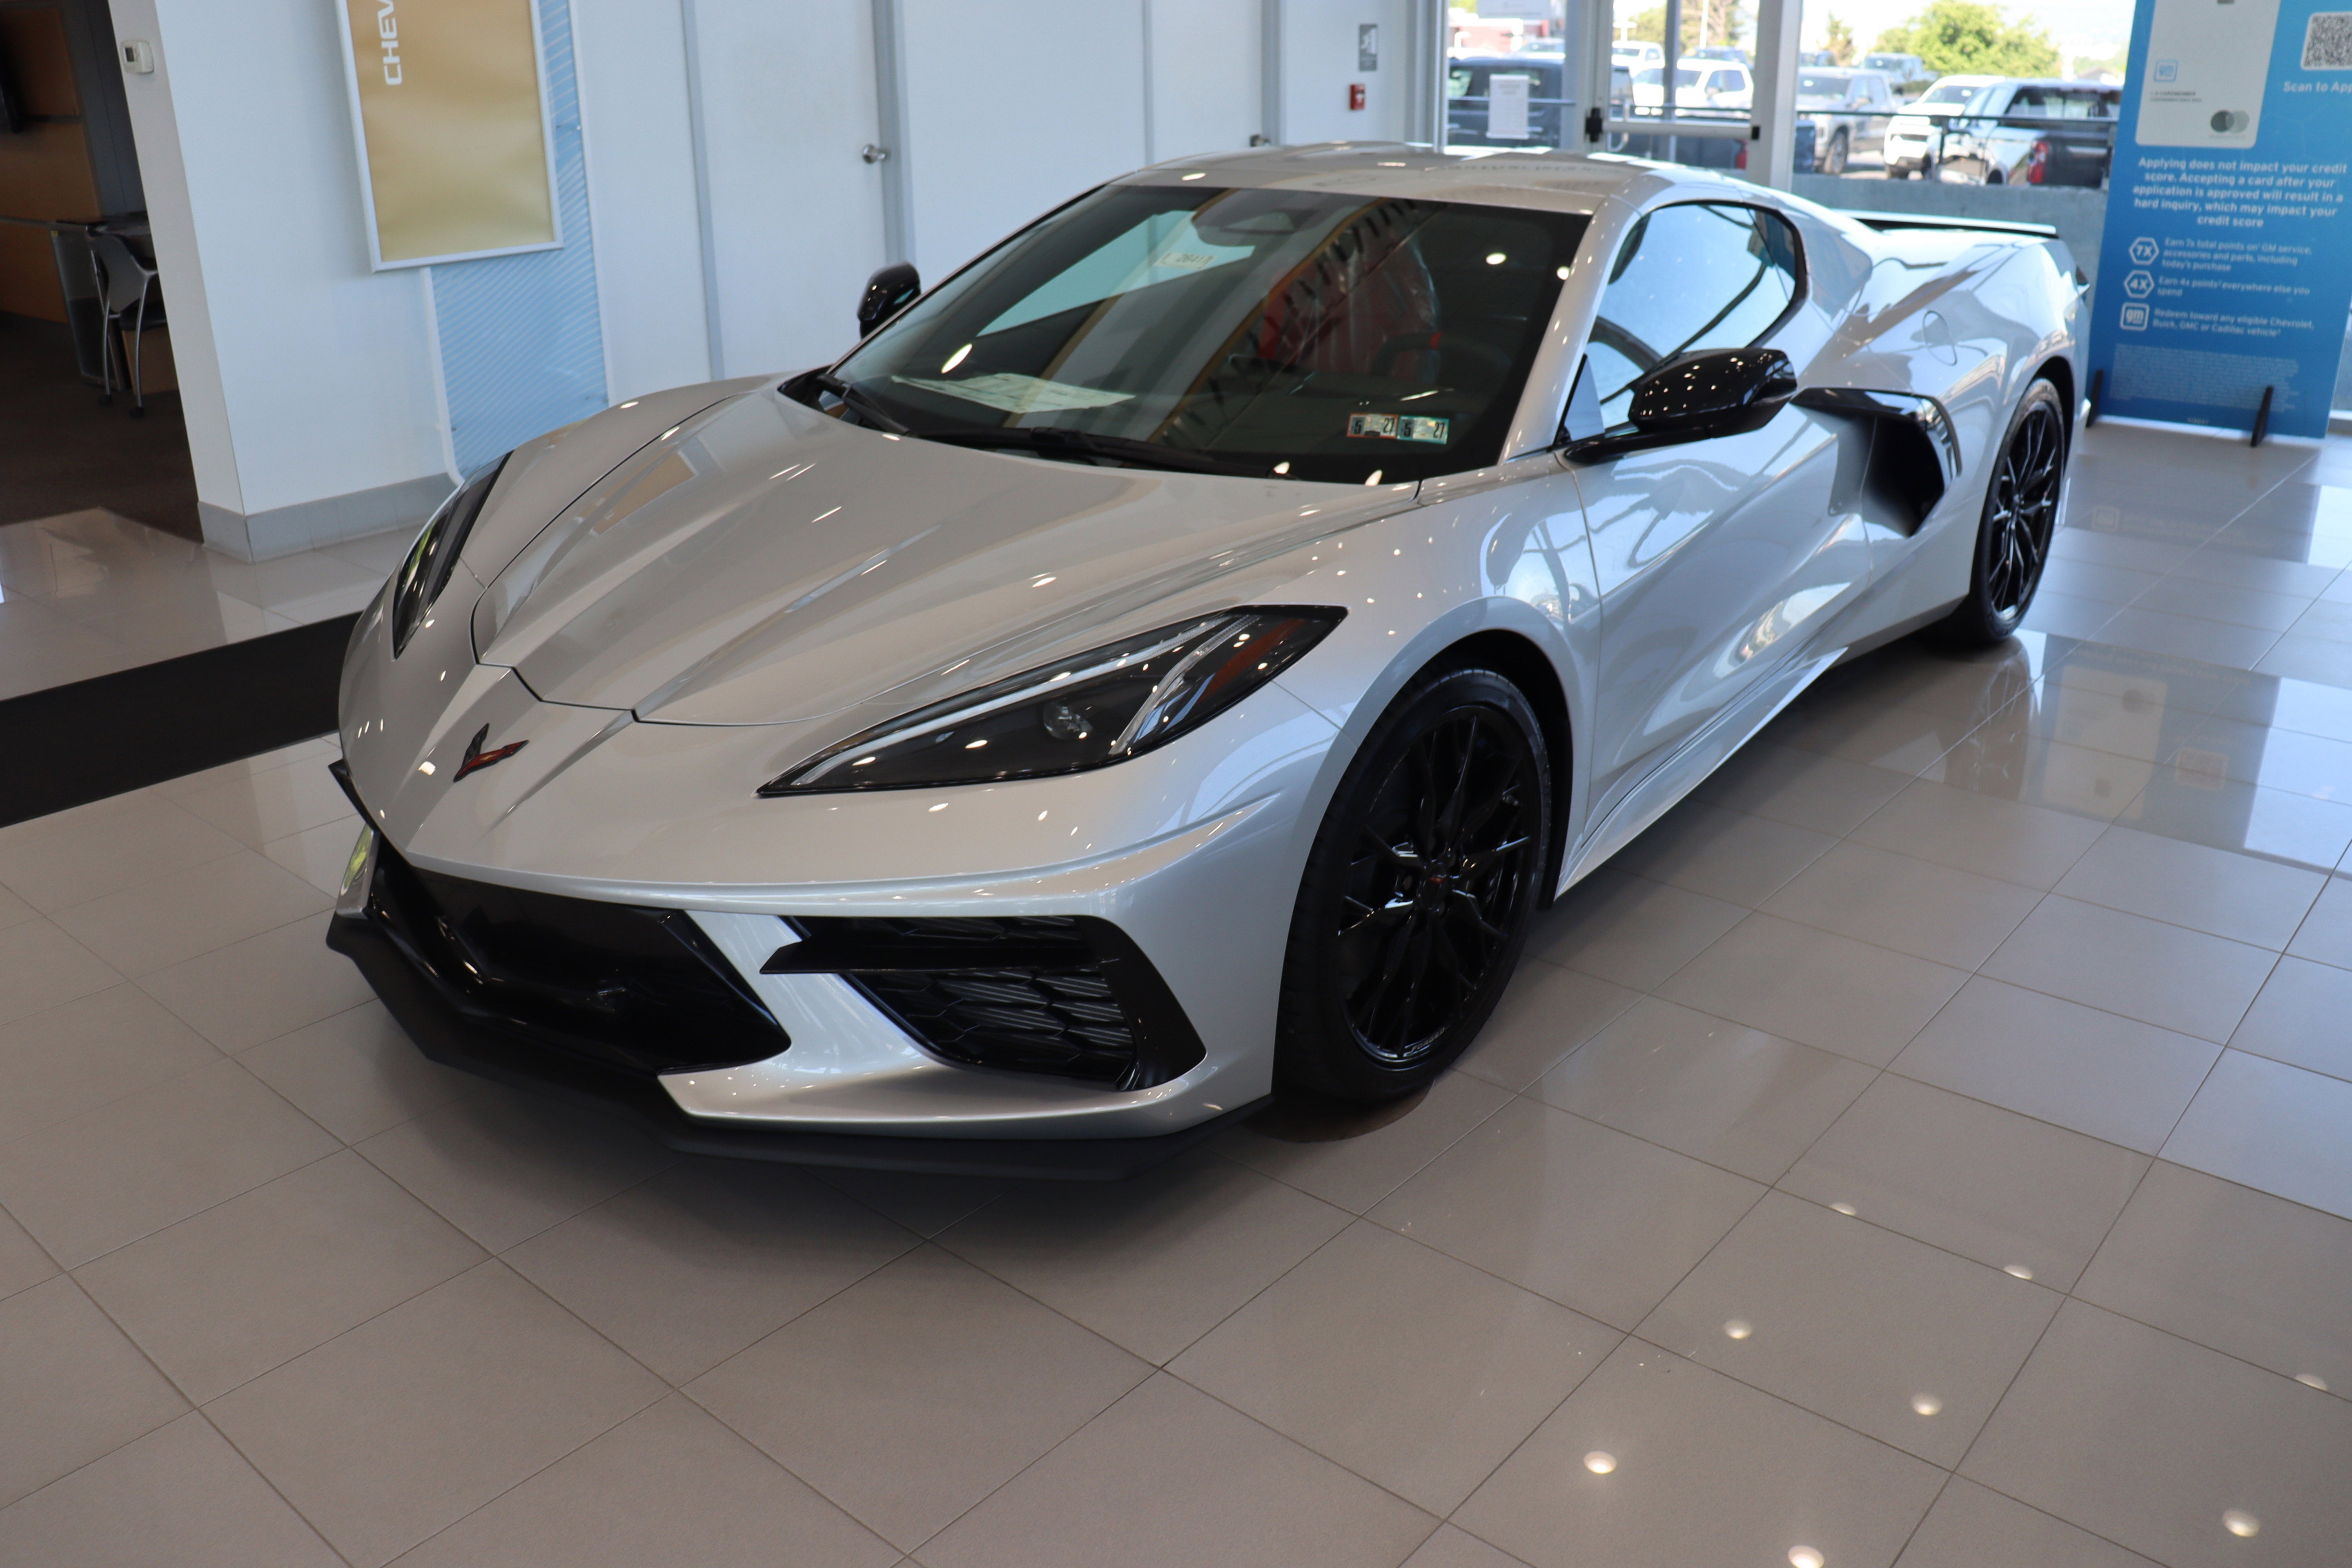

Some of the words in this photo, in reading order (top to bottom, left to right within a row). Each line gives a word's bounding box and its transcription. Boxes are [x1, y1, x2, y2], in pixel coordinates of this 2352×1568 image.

[377, 0, 402, 85] CHEV
[2283, 82, 2312, 92] Scan
[2316, 82, 2328, 92] to
[2138, 157, 2186, 170] Applying
[2189, 160, 2215, 169] does
[2218, 161, 2236, 170] not
[2239, 161, 2278, 172] impact
[2282, 164, 2309, 175] your
[2312, 163, 2347, 174] credit
[2145, 173, 2176, 182] score.
[2179, 173, 2236, 186] Accepting
[2248, 176, 2274, 186] card
[2276, 176, 2305, 187] after
[2309, 180, 2335, 189] your
[2133, 185, 2193, 196] application
[2195, 188, 2204, 197] is
[2207, 189, 2260, 200] approved
[2263, 189, 2282, 200] will
[2285, 192, 2319, 202] result
[2322, 192, 2333, 202] in
[2336, 194, 2344, 203] a
[2134, 198, 2159, 209] hard
[2162, 200, 2202, 212] inquiry,
[2205, 202, 2237, 212] which
[2240, 205, 2264, 216] may
[2267, 205, 2307, 216] impact
[2310, 208, 2337, 218] your
[2197, 216, 2230, 226] credit
[2232, 218, 2264, 228] score
[2136, 245, 2152, 257] 7X
[2165, 237, 2184, 247] Earn
[2196, 239, 2217, 249] total
[2218, 242, 2245, 251] points
[2262, 243, 2277, 252] GM
[2163, 250, 2211, 259] accessories
[2214, 252, 2230, 261] and
[2258, 255, 2298, 266] including
[2193, 262, 2232, 271] purchase
[2129, 278, 2149, 290] 4X
[2159, 276, 2178, 285] Earn
[2223, 283, 2272, 292] everywhere
[2274, 285, 2292, 294] else
[2294, 287, 2310, 296] you
[2157, 288, 2183, 297] spend
[2154, 308, 2188, 318] Redeem
[2190, 311, 2219, 322] toward
[2220, 315, 2235, 324] any
[2237, 316, 2268, 326] eligible
[2212, 324, 2245, 335] Cadillac
[1354, 420, 1363, 434] 5
[1383, 417, 1395, 434] 27
[1403, 422, 1412, 437] 5
[1433, 422, 1446, 439] 27
